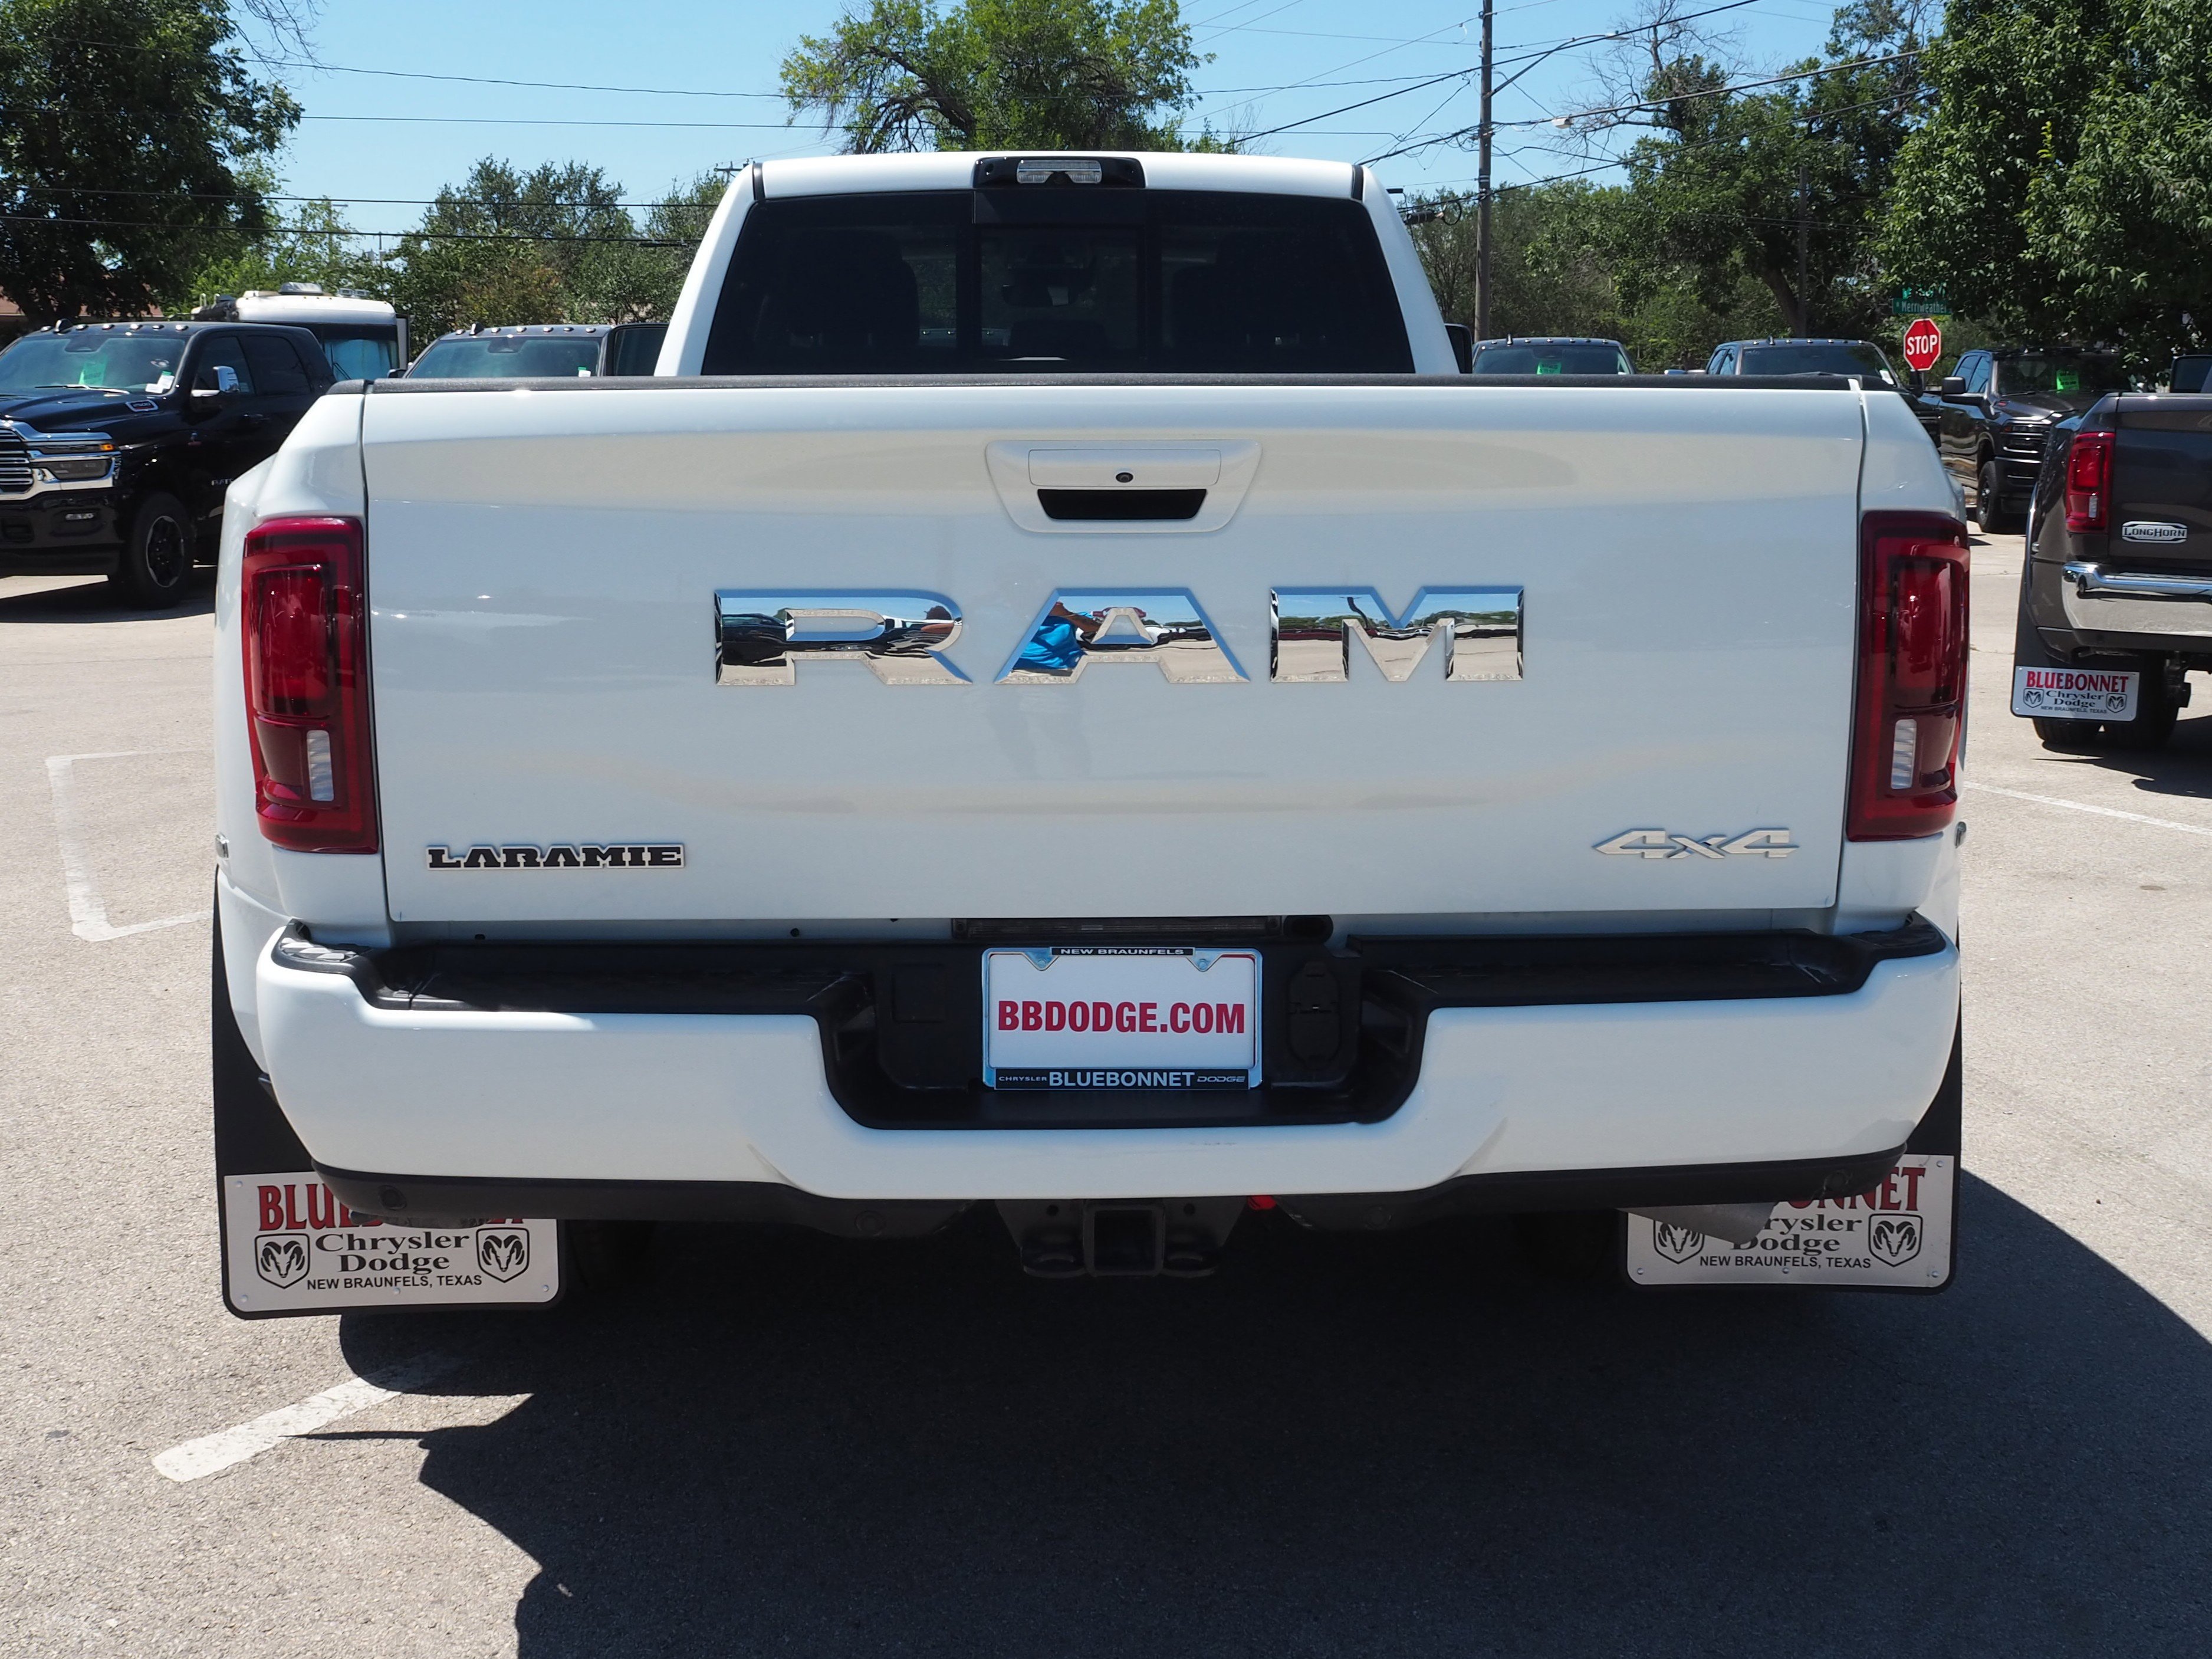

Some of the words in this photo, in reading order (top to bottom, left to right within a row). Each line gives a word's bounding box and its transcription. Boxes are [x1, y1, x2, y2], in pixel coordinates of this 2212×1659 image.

[1907, 334, 1938, 355] STOP
[2124, 527, 2185, 537] LONGHORN
[714, 588, 1524, 686] RAM
[2026, 671, 2129, 692] BLUEBONNET
[2046, 690, 2104, 700] Chrysler
[2053, 698, 2096, 708] Dodge
[427, 844, 685, 869] LARAMIE
[998, 1000, 1245, 1033] BBDODGE.COM
[1049, 1072, 1195, 1087] BLUEBONNET
[1763, 1214, 1862, 1235] rysler
[315, 1231, 469, 1254] Chrysler
[337, 1253, 450, 1274] Dodge
[1700, 1255, 1731, 1266] NEW
[1735, 1256, 1822, 1269] BRAUNFELS,
[1826, 1257, 1871, 1268] TEXAS
[307, 1278, 340, 1290] NEW
[344, 1275, 432, 1289] BRAUNFELS,
[437, 1274, 482, 1286] TEXAS
